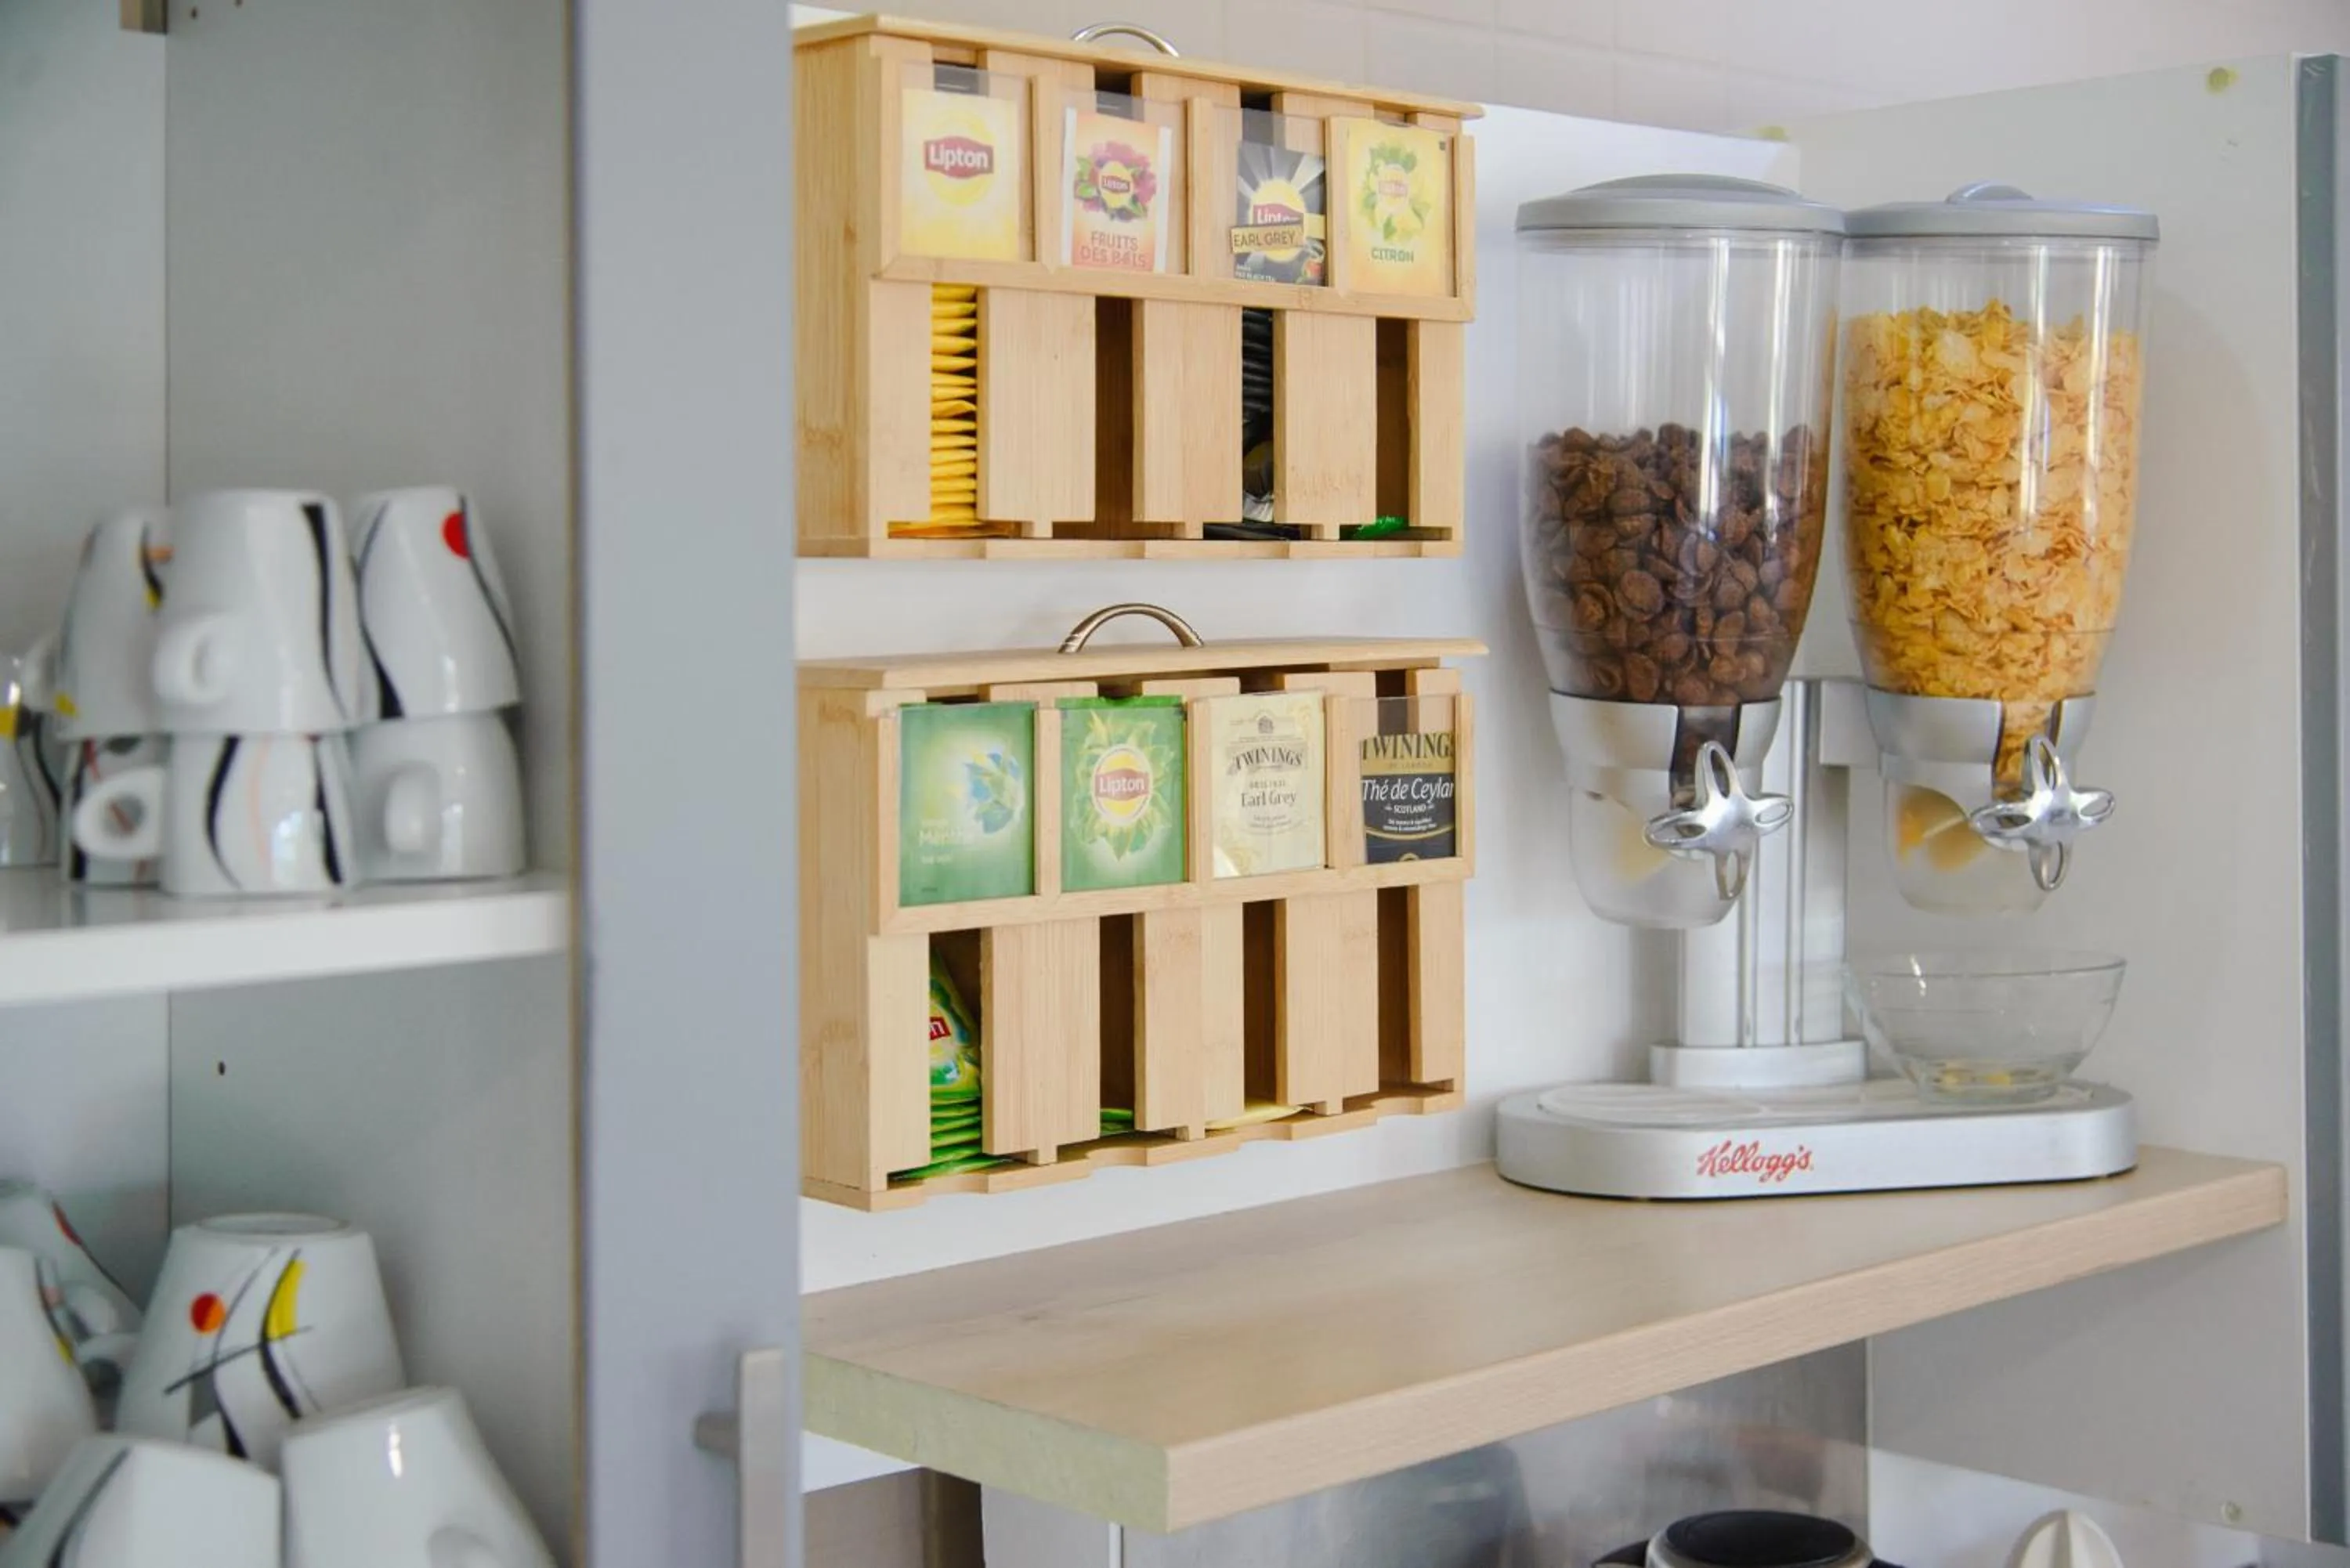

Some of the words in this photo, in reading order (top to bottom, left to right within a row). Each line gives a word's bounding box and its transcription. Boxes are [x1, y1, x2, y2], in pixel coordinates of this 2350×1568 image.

[928, 144, 989, 170] Lipton
[1257, 208, 1300, 224] Lipt
[1090, 230, 1139, 251] FRUITS
[1234, 232, 1262, 247] EARL
[1264, 229, 1296, 245] GREY
[1079, 245, 1108, 262] DES
[1371, 246, 1415, 263] CITRON
[1233, 746, 1303, 771] TWININGS
[1098, 775, 1145, 797] Lipton
[1361, 779, 1389, 801] Thé
[1390, 778, 1409, 800] de
[1241, 790, 1267, 808] Earl
[1268, 790, 1296, 807] Grey
[1696, 1140, 1812, 1183] Kellogg's
